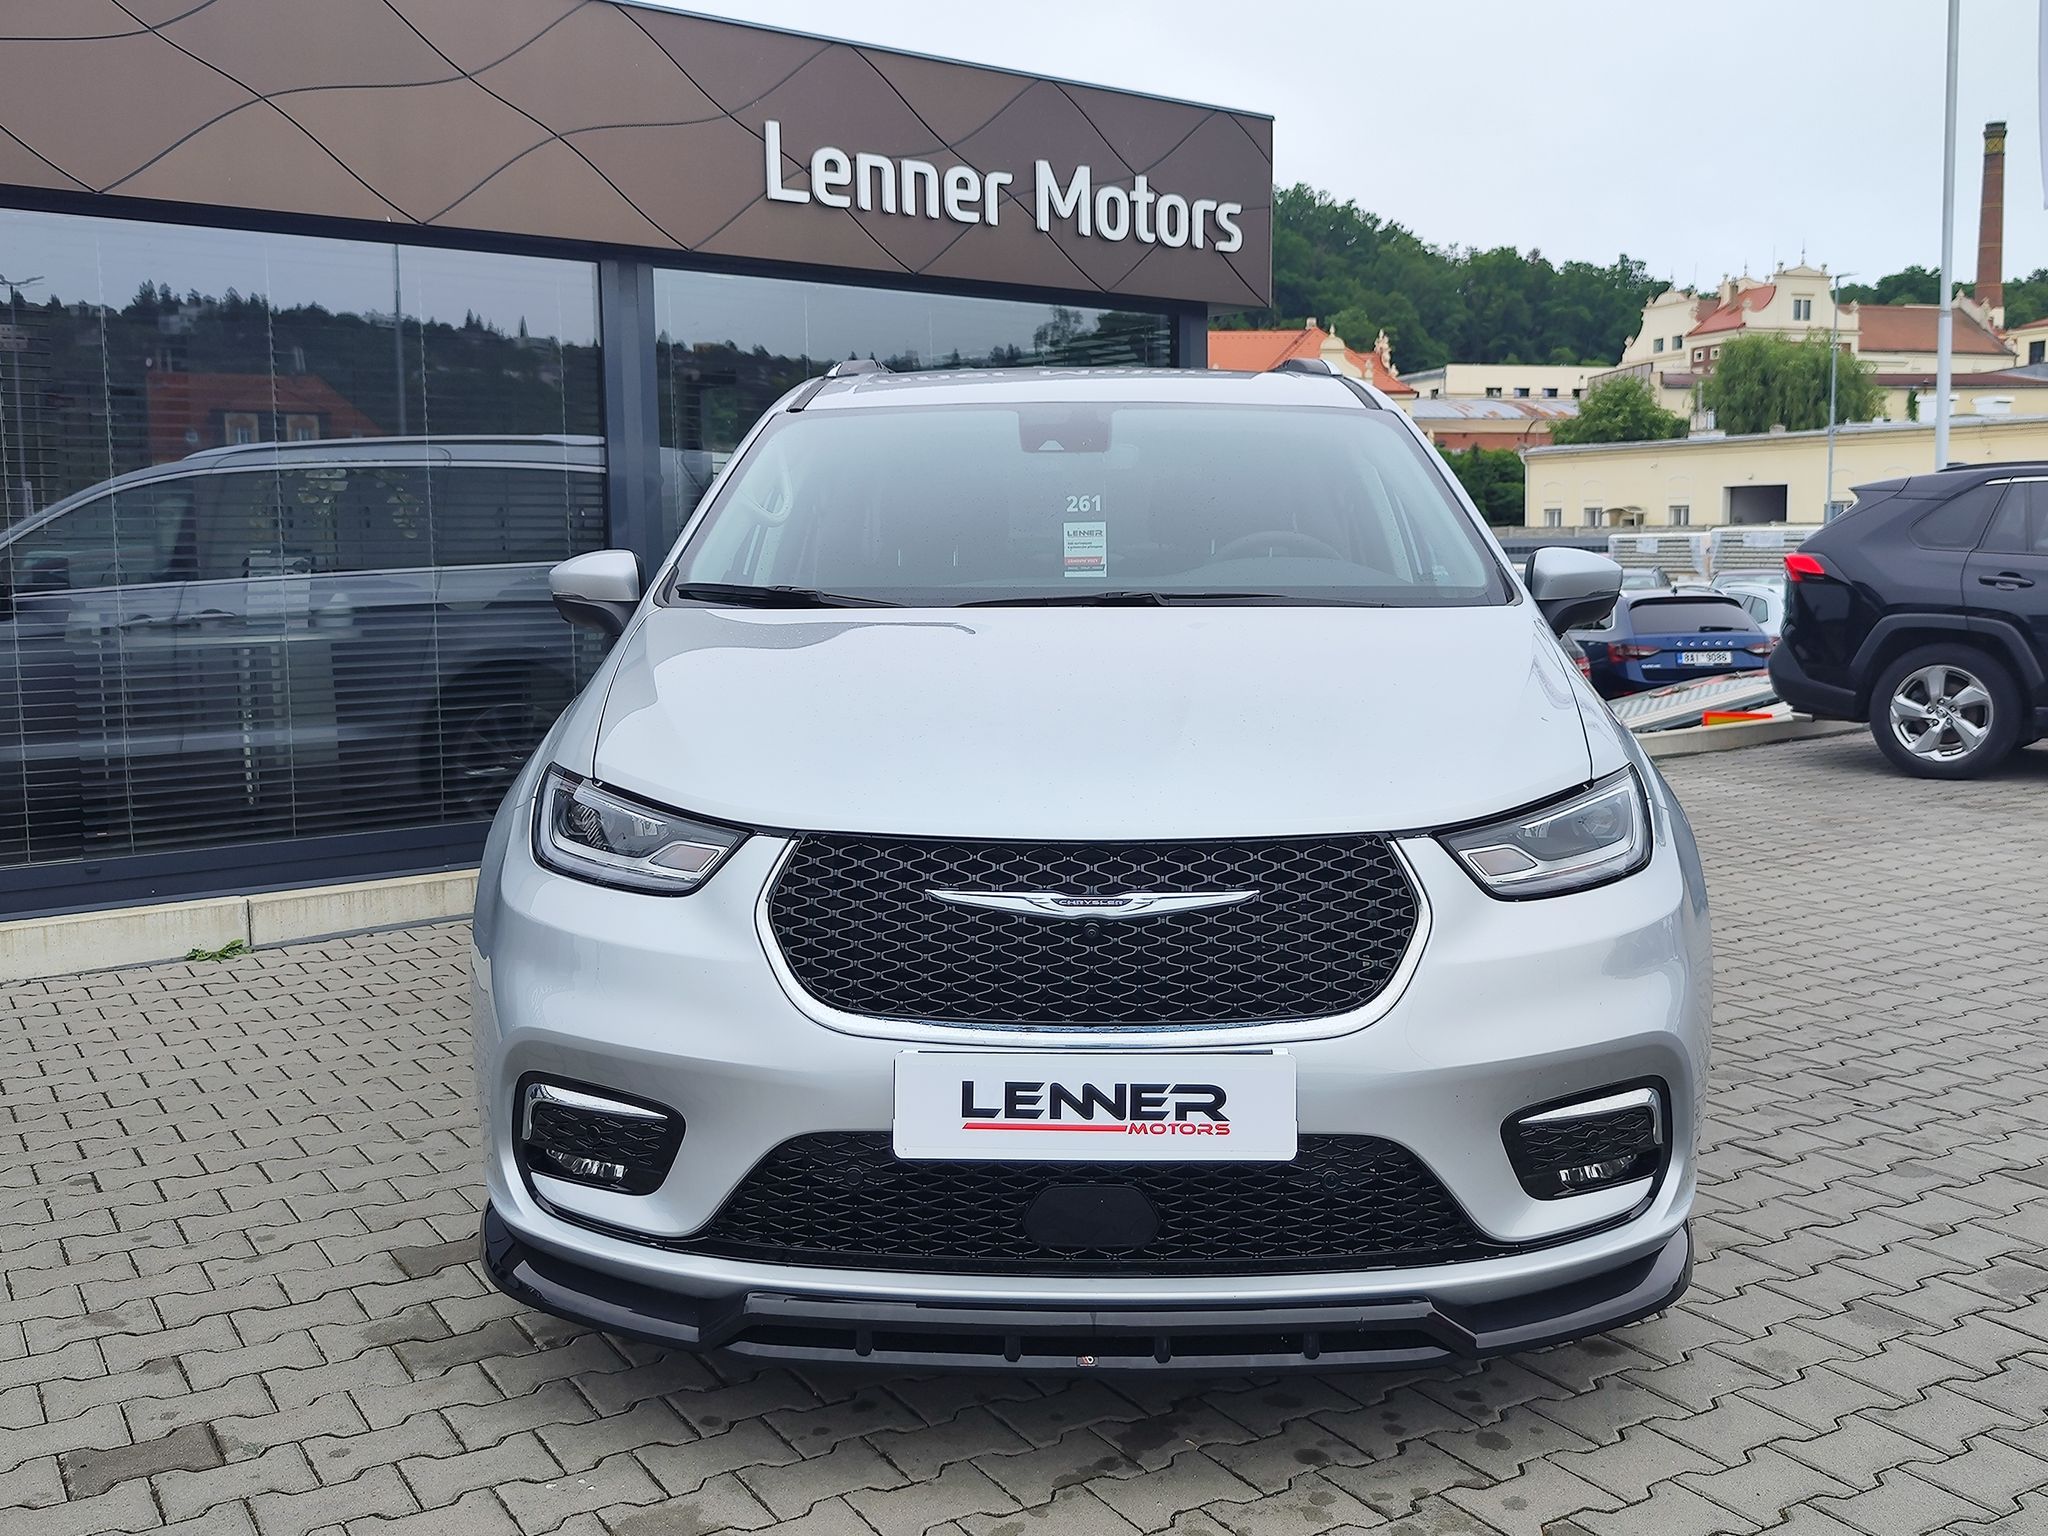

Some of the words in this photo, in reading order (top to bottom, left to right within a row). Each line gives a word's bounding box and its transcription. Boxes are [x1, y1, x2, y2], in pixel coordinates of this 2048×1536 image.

[763, 119, 1014, 228] Lenner
[1034, 159, 1244, 254] Motors
[1066, 494, 1101, 513] 261
[1066, 529, 1104, 538] LENNER
[961, 1080, 1231, 1122] LENNER
[1127, 1122, 1231, 1136] MOTORS
